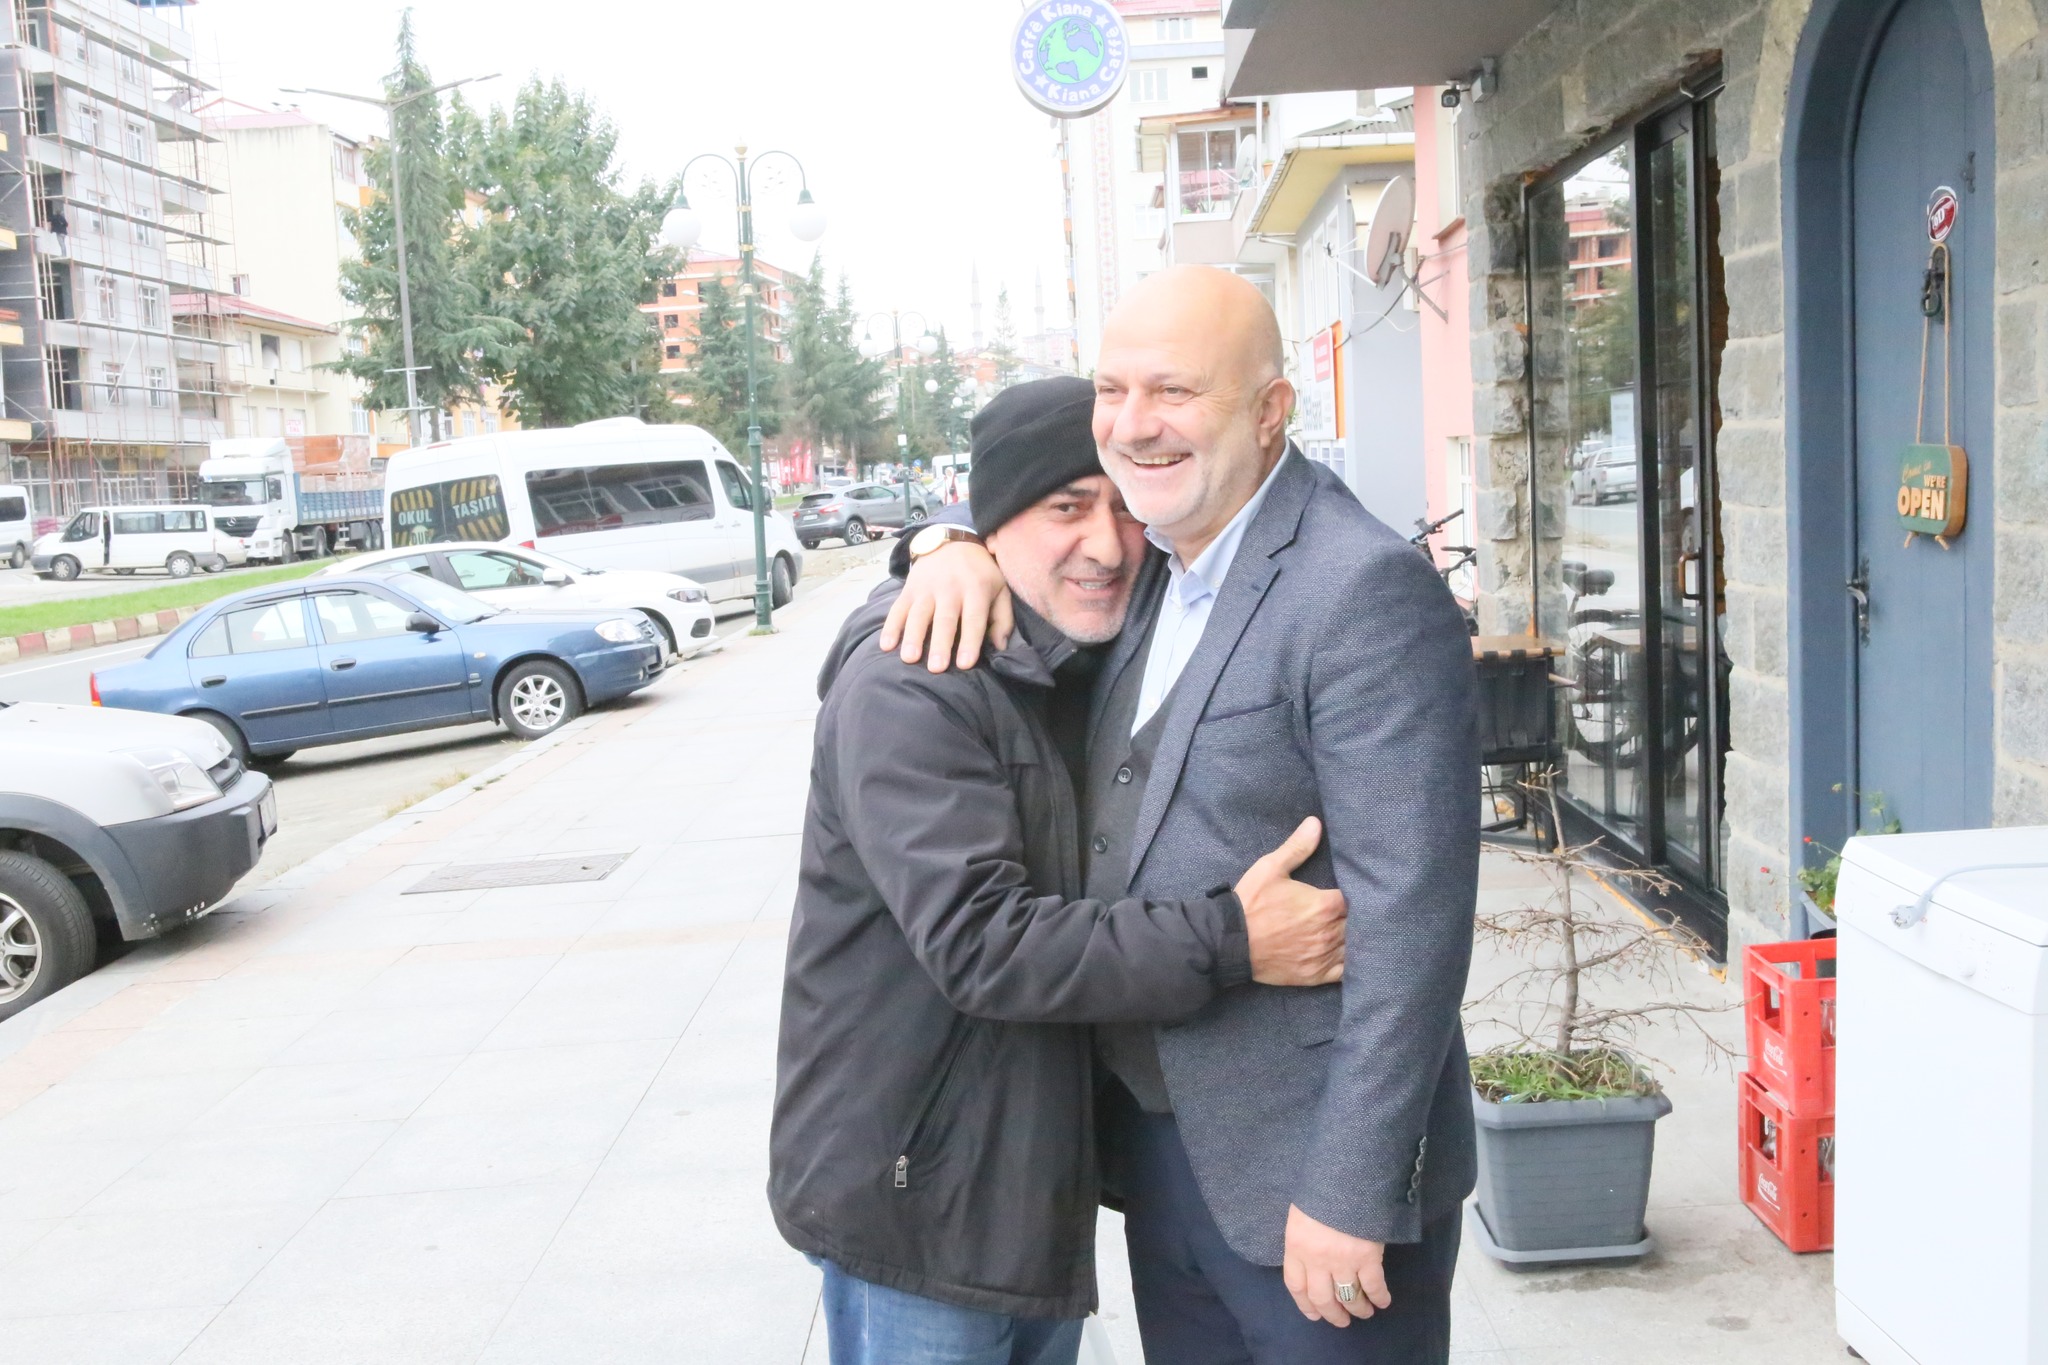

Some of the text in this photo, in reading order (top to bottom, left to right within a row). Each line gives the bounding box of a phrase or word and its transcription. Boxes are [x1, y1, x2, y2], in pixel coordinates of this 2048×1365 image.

[1041, 3, 1093, 22] Kiana
[1047, 83, 1101, 102] Kiana
[1923, 474, 1947, 489] WE'RE
[398, 494, 498, 526] OKUL TAŞITI
[1897, 485, 1945, 521] OPEN
